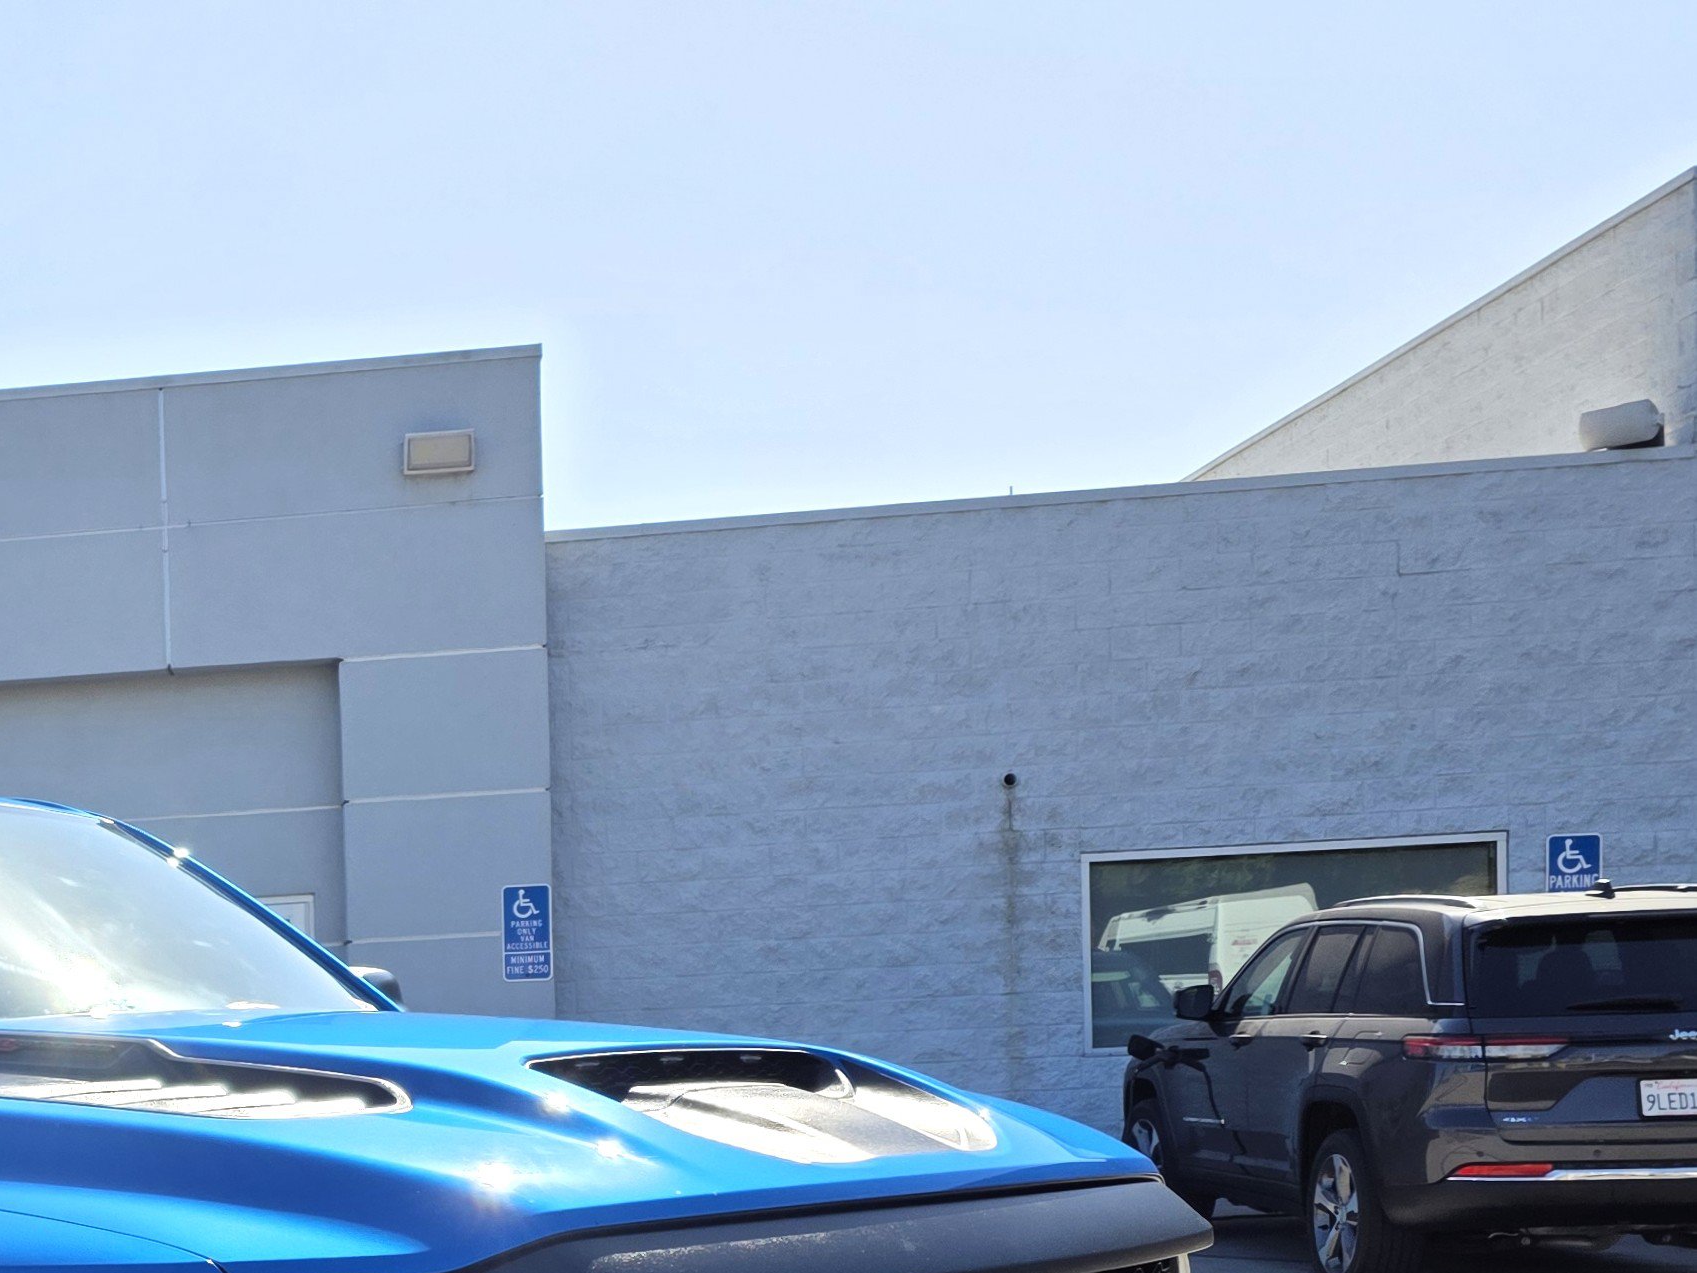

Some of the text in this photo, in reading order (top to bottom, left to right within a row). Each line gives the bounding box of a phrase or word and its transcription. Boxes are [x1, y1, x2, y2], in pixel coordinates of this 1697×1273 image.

[1549, 873, 1599, 889] PARKING
[510, 920, 543, 928] PARKING
[517, 928, 537, 936] ONLY
[506, 941, 548, 950] ACCESSIBLE
[510, 955, 545, 964] MINIMUM
[506, 966, 524, 974] FINE
